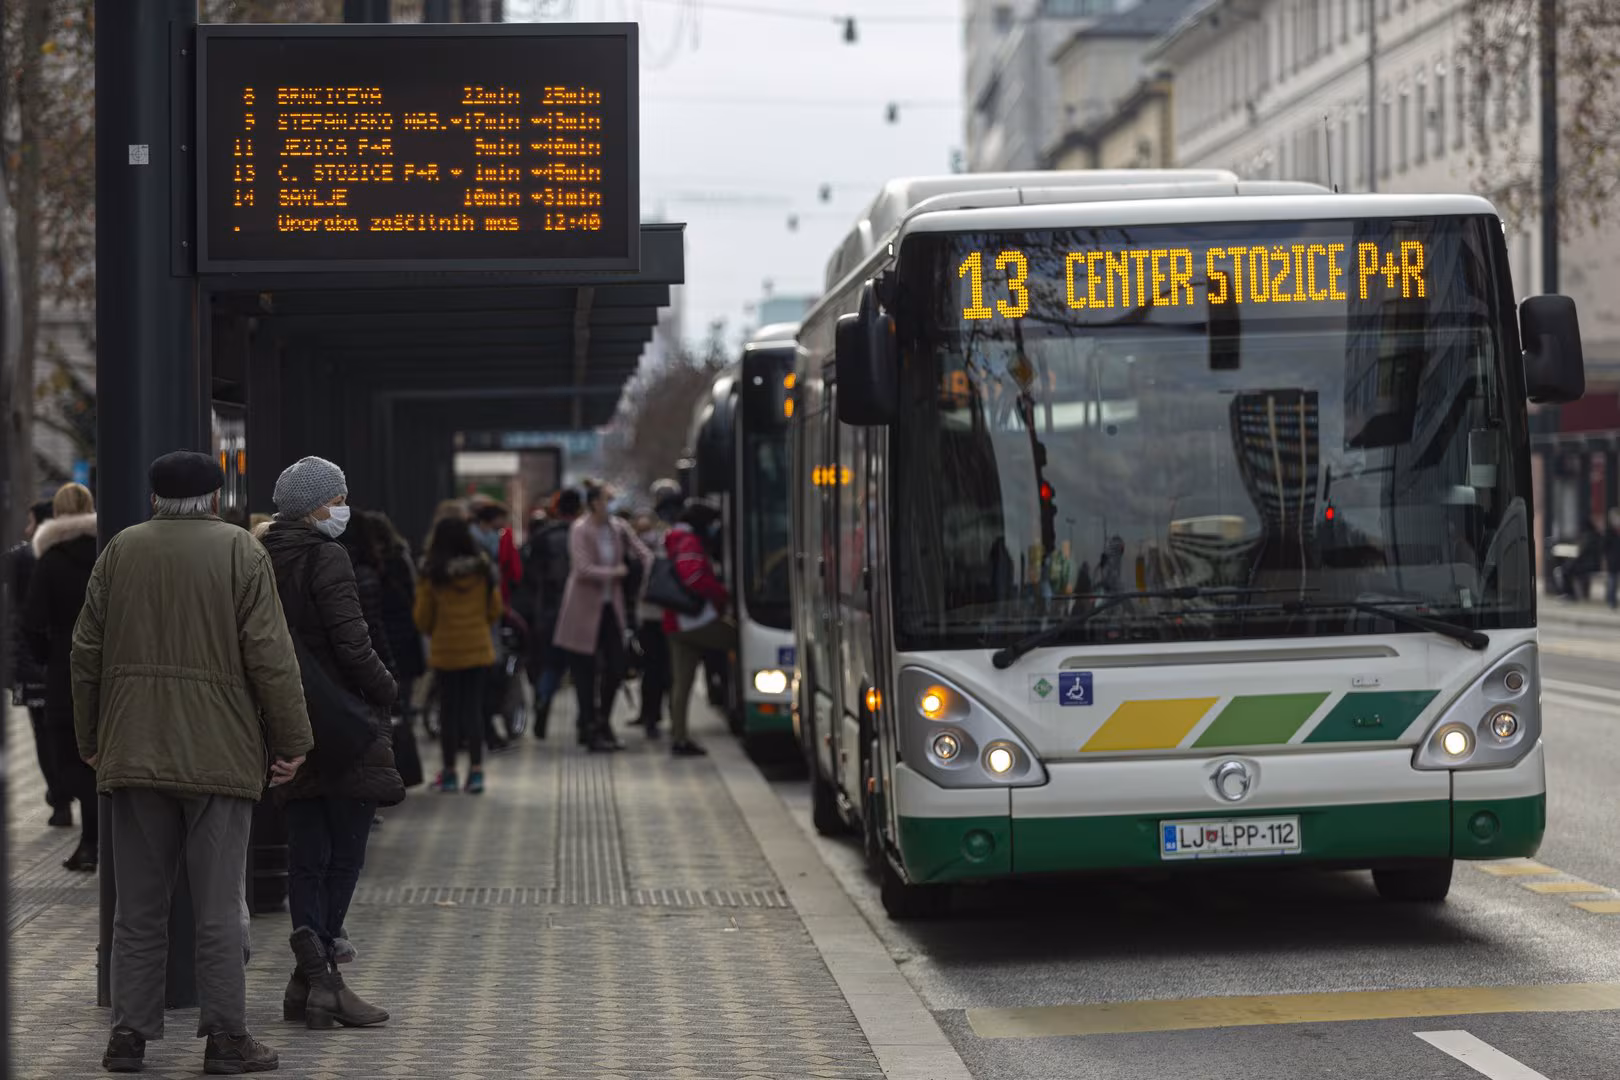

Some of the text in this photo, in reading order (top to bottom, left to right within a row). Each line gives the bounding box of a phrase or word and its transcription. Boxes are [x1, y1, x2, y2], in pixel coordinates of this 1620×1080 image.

[461, 86, 520, 105] 22min
[542, 85, 600, 105] 25min
[464, 112, 520, 130] 17min
[234, 138, 254, 157] 11
[233, 164, 255, 182] 13
[404, 163, 440, 182] P+R
[475, 163, 520, 182] 1min
[233, 187, 601, 207] 14 SAVLJE 10min 31min
[277, 214, 360, 232] Uporaba
[484, 216, 520, 231] mas
[544, 213, 601, 231] 12:40
[958, 250, 1029, 320] 13
[1065, 248, 1194, 309] CENTER
[1358, 241, 1426, 299] P+R
[1179, 822, 1296, 849] LJ LPP-112
